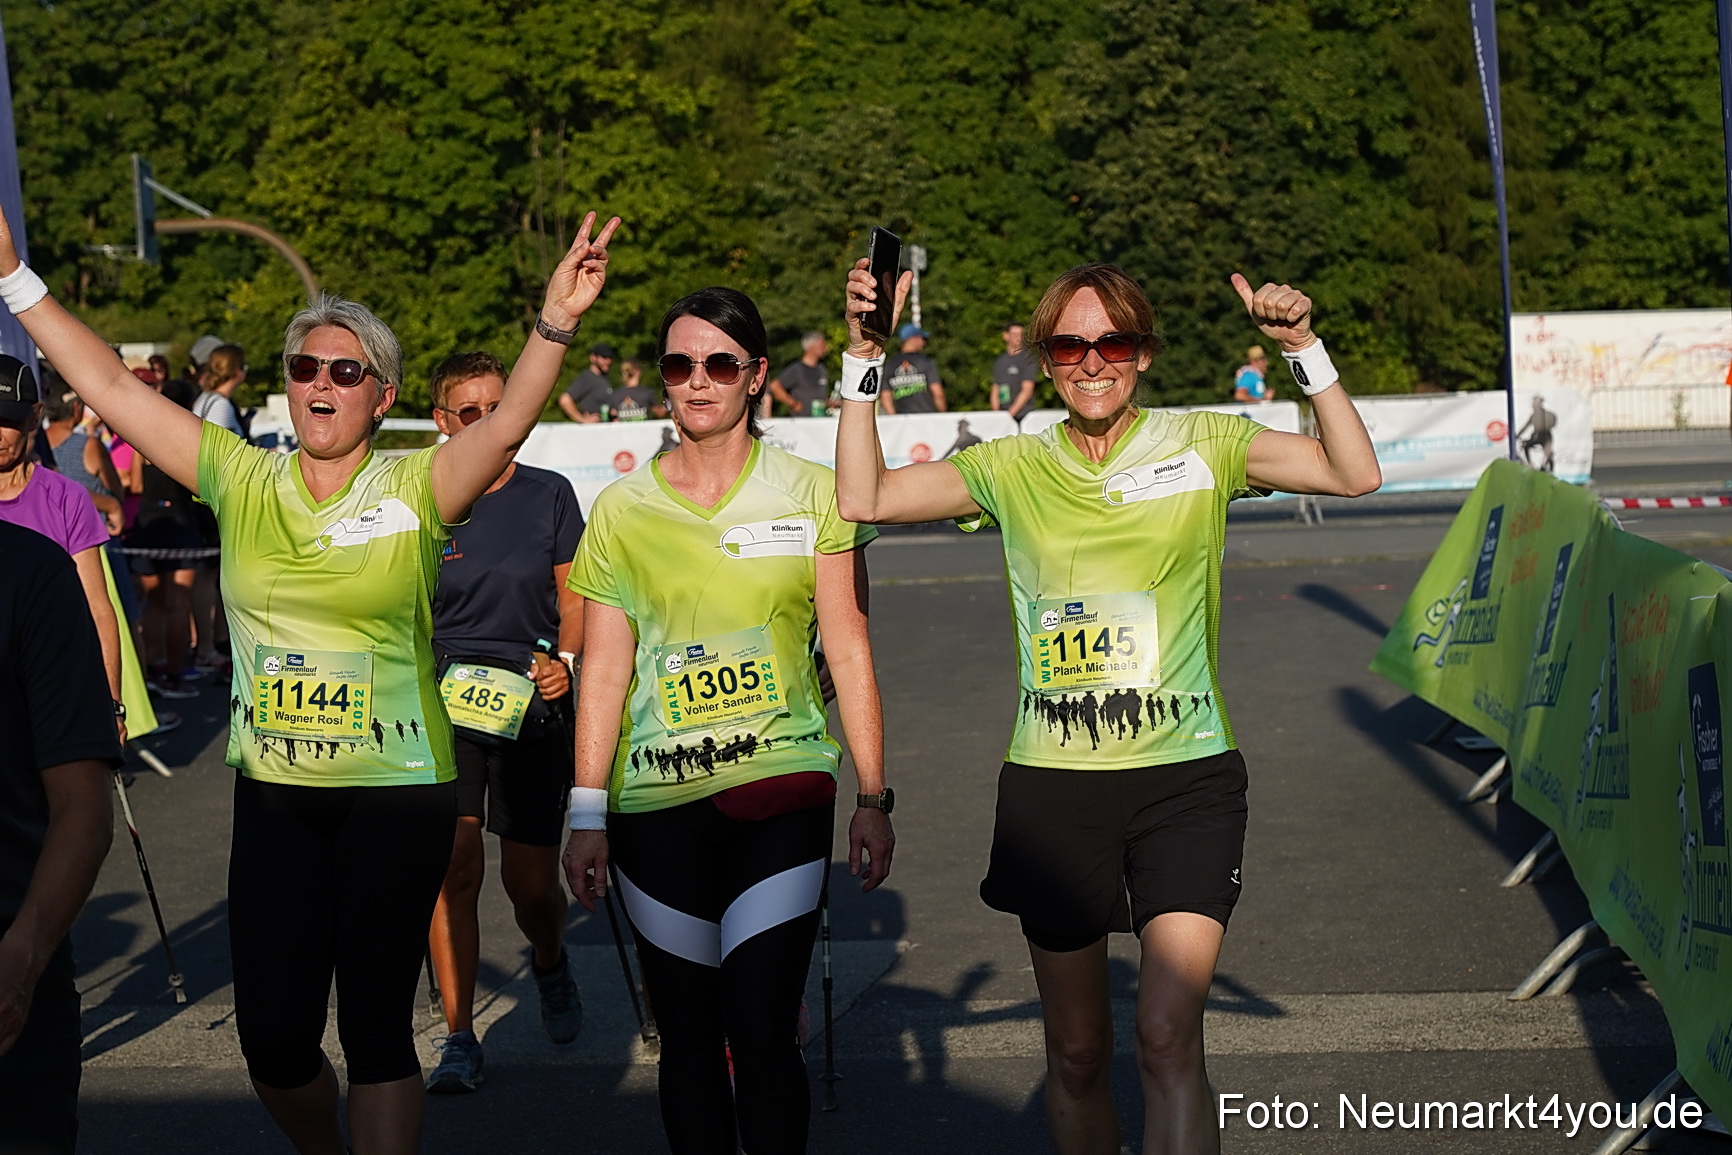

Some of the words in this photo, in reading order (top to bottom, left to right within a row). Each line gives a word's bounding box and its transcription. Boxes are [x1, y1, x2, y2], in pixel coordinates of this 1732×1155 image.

[1154, 461, 1186, 476] Klinikum
[1154, 468, 1186, 480] Neumarkt
[771, 524, 803, 532] Klinikum
[1060, 611, 1099, 624] Firmenlauf
[1052, 626, 1137, 662] 1145
[281, 665, 318, 673] Firmenlauf
[684, 652, 719, 667] Firmenlauf
[1038, 638, 1051, 683] WALK
[1053, 663, 1083, 677] Plank
[1085, 660, 1138, 673] Michaela
[443, 682, 455, 702] ALK
[678, 660, 760, 702] 1305
[760, 661, 779, 702] 2022
[259, 681, 269, 723] WALK
[271, 679, 351, 712] 1144
[459, 685, 508, 712] 485
[665, 680, 682, 724] WALK
[684, 702, 720, 716] Vohler
[722, 693, 763, 709] Sandra
[275, 711, 315, 724] Wagner
[318, 715, 344, 725] Rosi
[352, 689, 365, 730] 2022
[508, 700, 524, 729] 2022
[1696, 721, 1718, 753] Fischer
